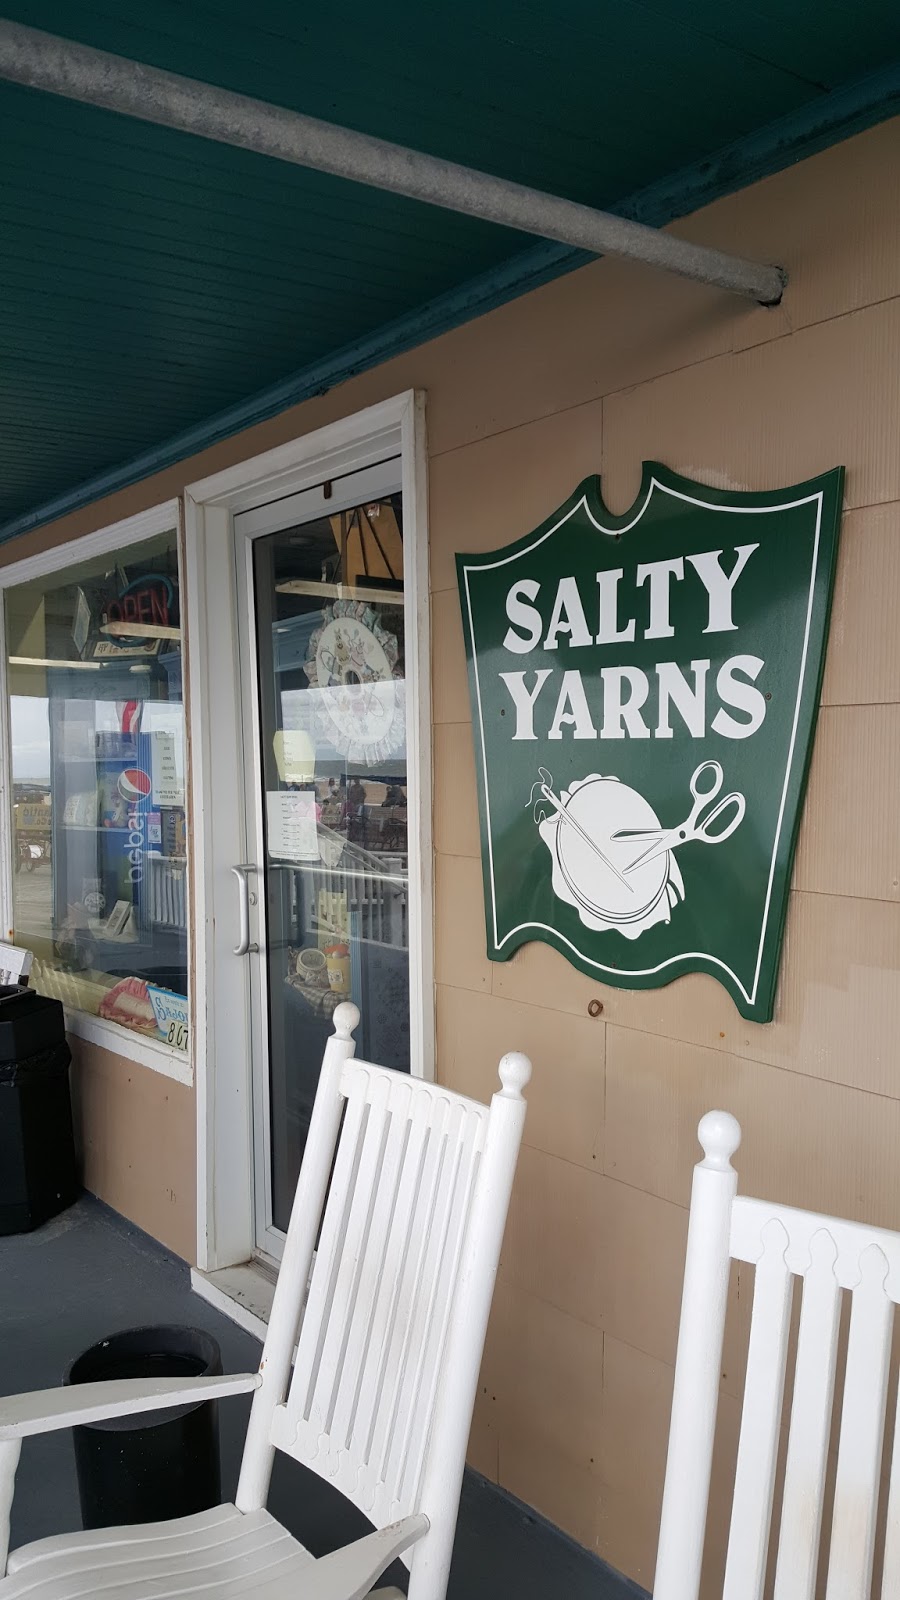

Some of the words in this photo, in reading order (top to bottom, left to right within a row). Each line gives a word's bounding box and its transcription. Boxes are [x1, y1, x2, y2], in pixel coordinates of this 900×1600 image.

[107, 585, 169, 628] OPEN
[502, 543, 760, 654] SALTY
[498, 654, 767, 740] YARNS
